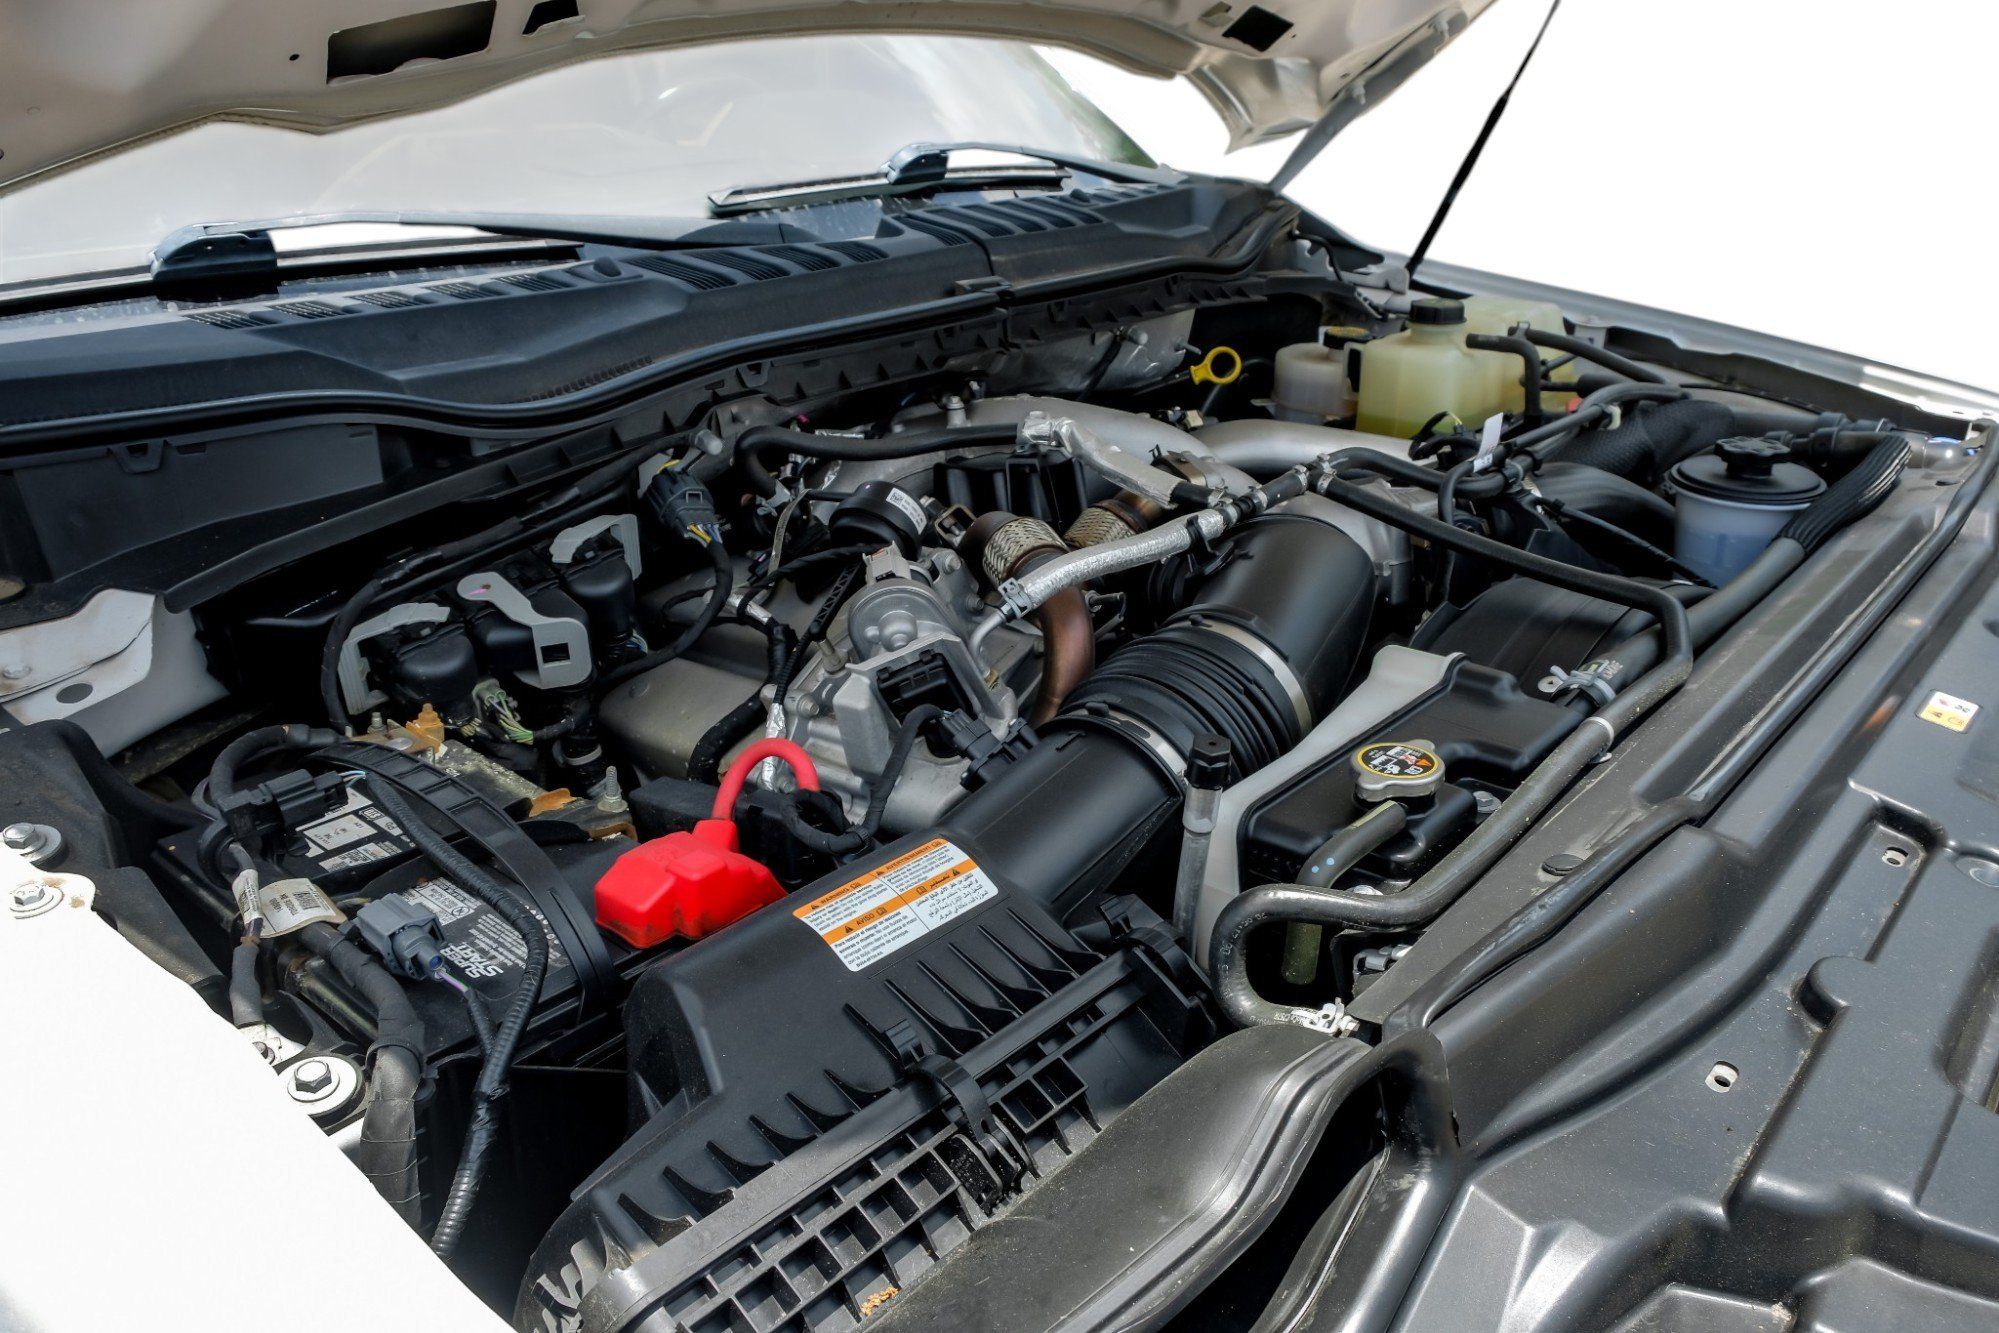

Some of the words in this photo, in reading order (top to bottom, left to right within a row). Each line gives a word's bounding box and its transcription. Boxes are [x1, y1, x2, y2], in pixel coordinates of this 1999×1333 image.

[820, 887, 848, 903] WARNING
[855, 913, 875, 925] AVISO
[438, 946, 486, 979] SUPER
[448, 942, 503, 975] START
